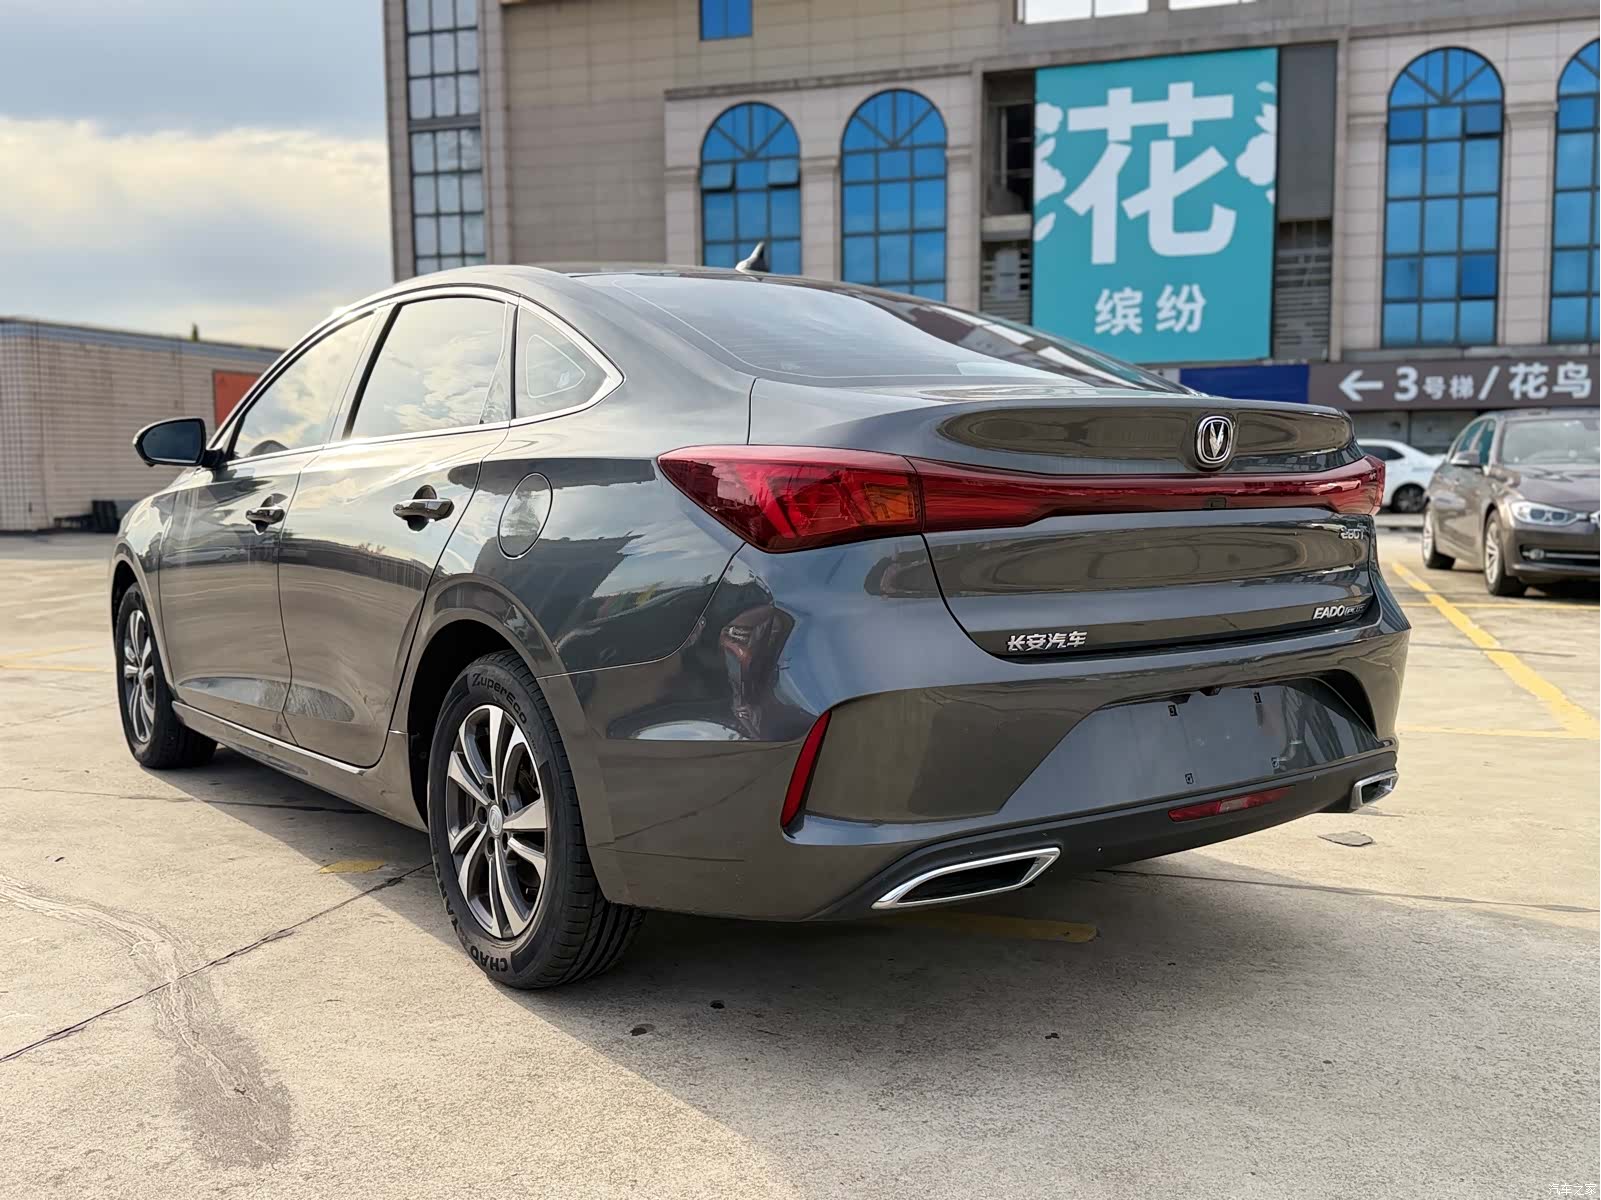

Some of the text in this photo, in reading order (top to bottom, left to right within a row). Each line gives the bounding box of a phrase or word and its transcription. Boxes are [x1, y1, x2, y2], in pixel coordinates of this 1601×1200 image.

[1064, 81, 1237, 265] 花
[1094, 284, 1206, 336] 缤纷
[1313, 605, 1345, 620] EADO
[1007, 630, 1088, 652] 长安汽车
[472, 672, 528, 725] ZuperEco
[470, 945, 509, 972] CHAO
